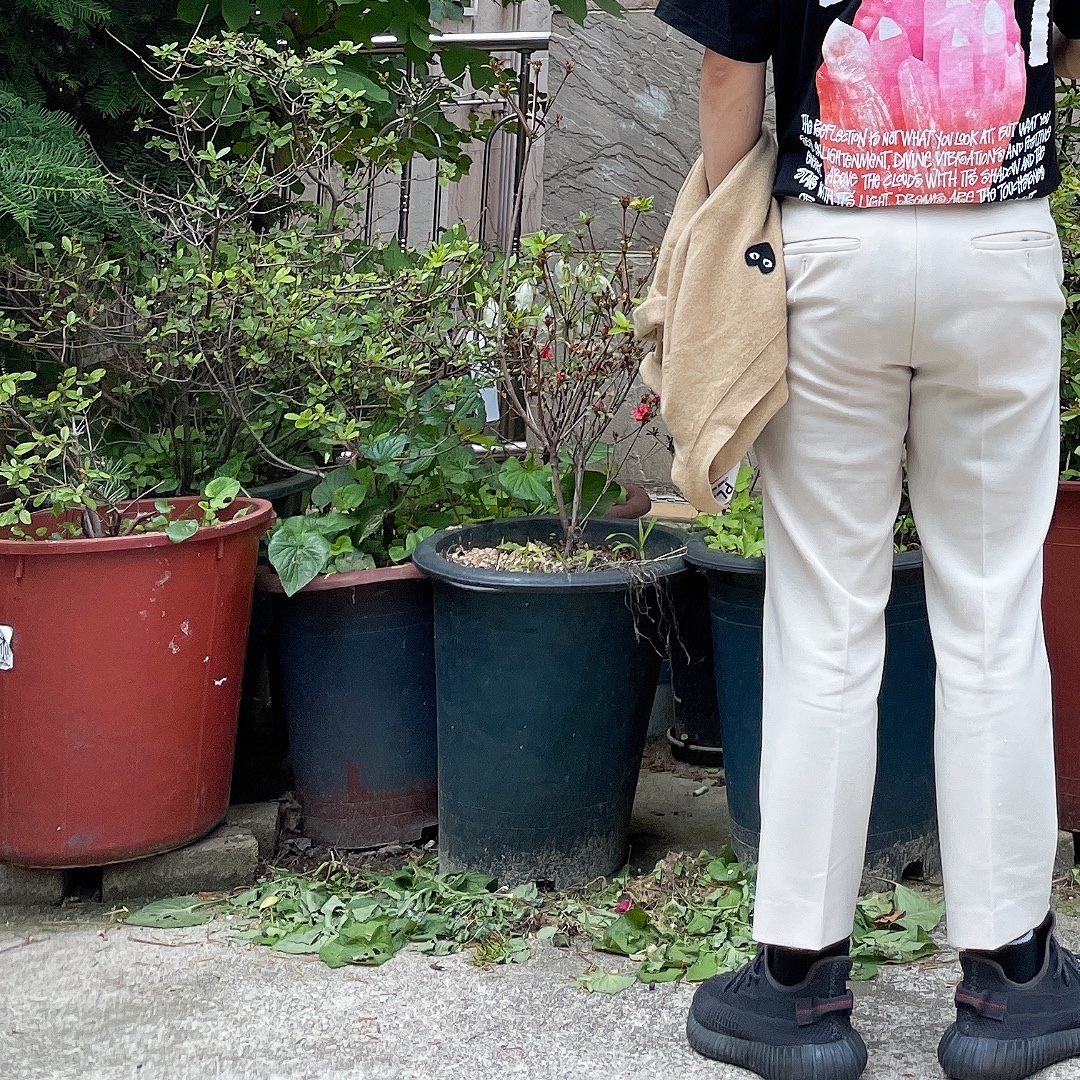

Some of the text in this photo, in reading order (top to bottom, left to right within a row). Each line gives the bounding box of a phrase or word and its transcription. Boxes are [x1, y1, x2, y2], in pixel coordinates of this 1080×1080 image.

[869, 130, 880, 147] IS
[881, 128, 901, 147] NOT
[900, 128, 936, 148] WHAT
[935, 131, 953, 149] YOU
[954, 130, 979, 146] LOOK
[998, 121, 1019, 139] BUT
[1018, 113, 1041, 137] WHAT
[883, 170, 924, 189] CLOUDS
[925, 168, 957, 189] WITH
[980, 159, 1021, 184] SHADOW
[1019, 153, 1036, 171] AND
[935, 146, 1006, 168] VIBRATIONS
[1005, 142, 1024, 160] AND
